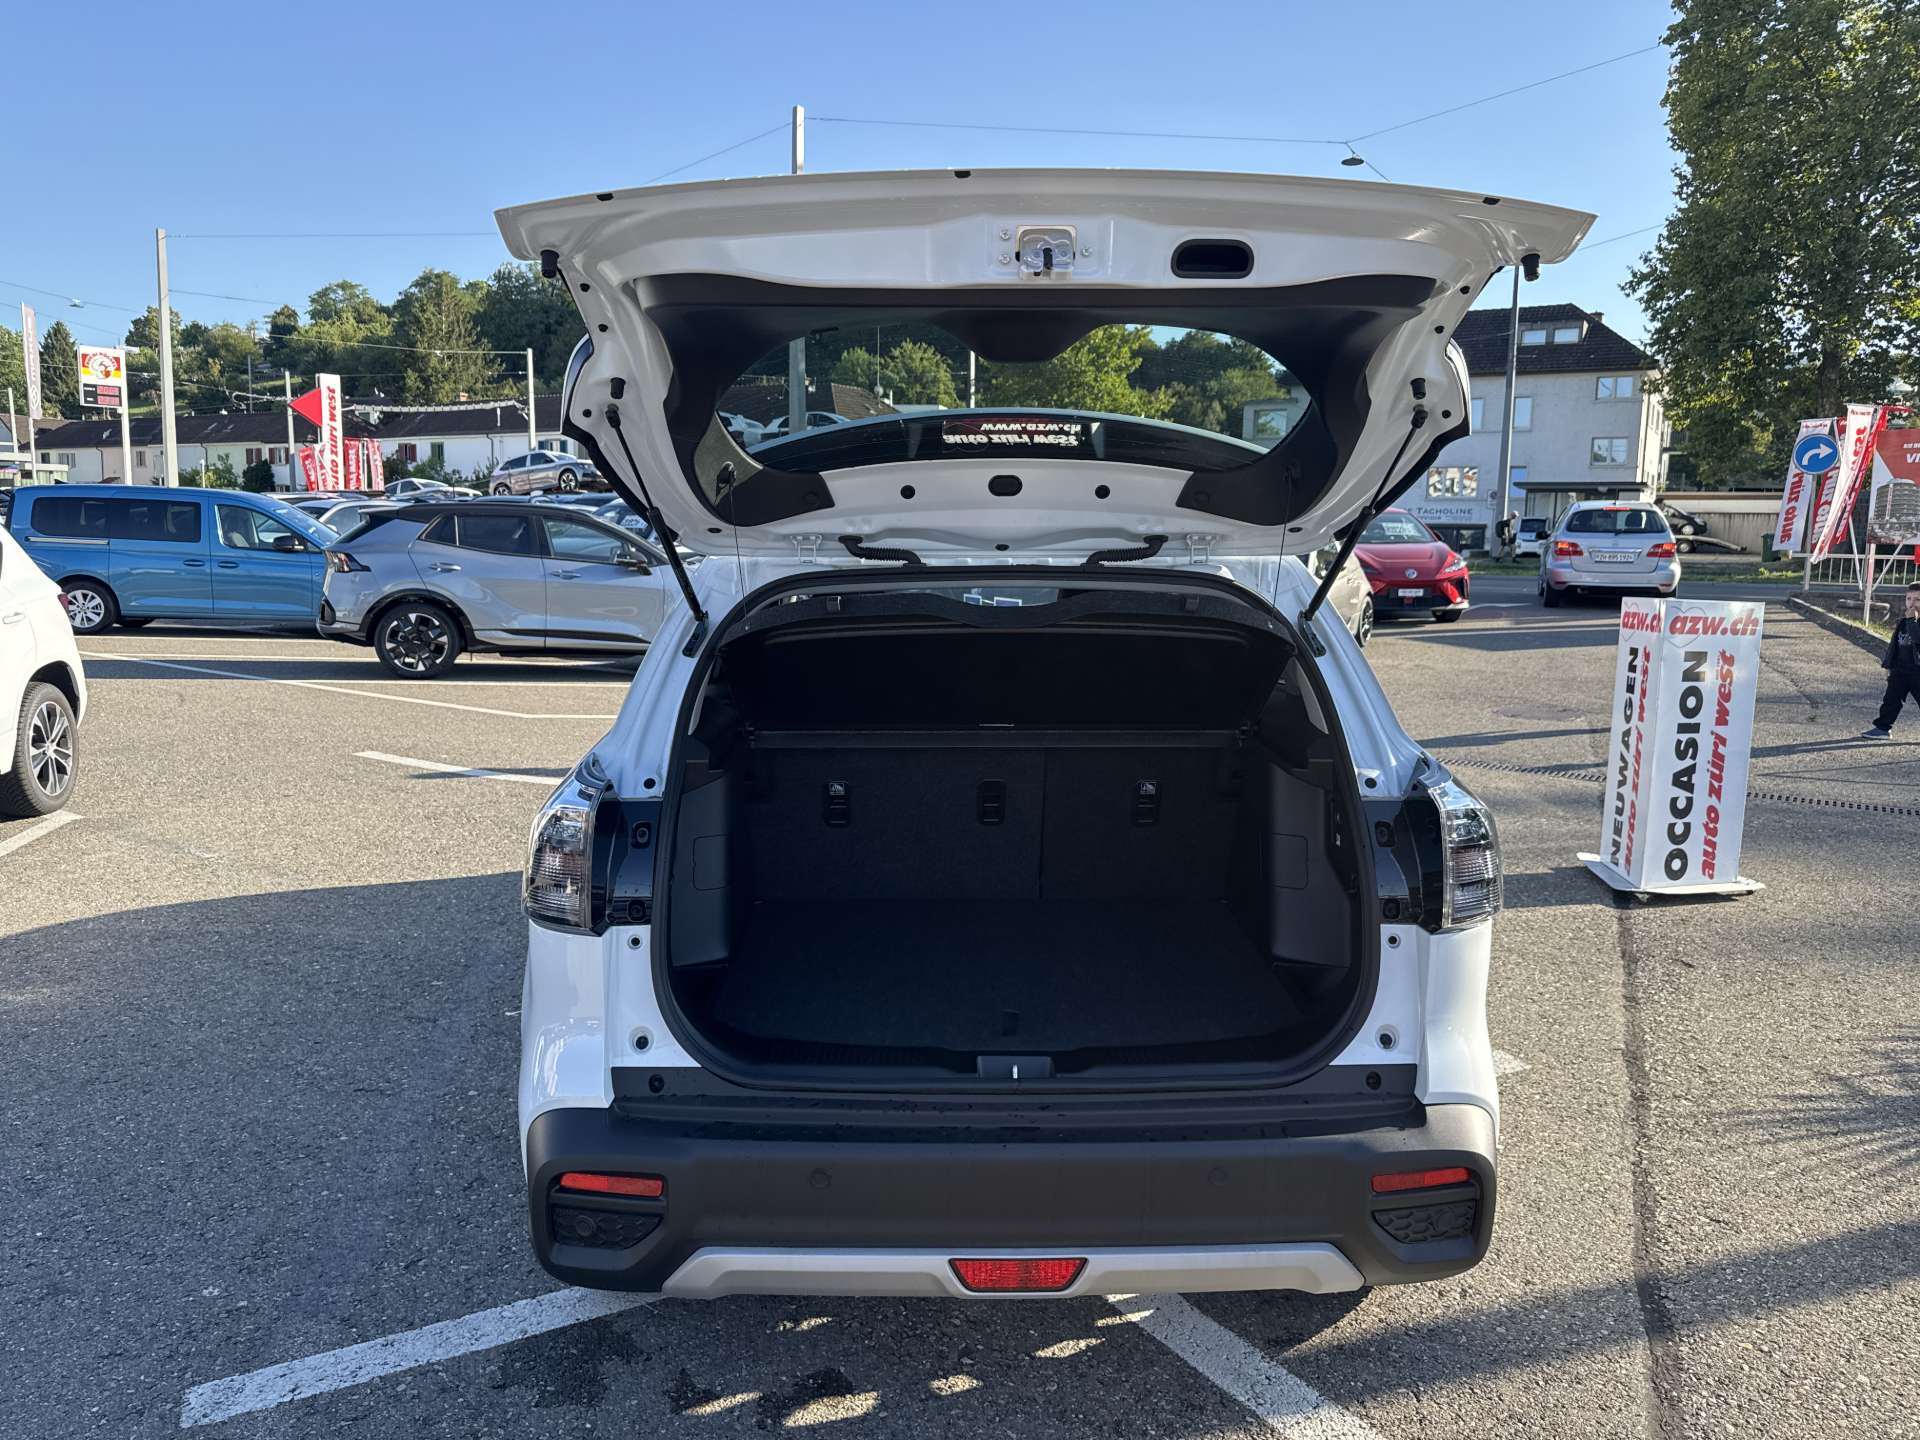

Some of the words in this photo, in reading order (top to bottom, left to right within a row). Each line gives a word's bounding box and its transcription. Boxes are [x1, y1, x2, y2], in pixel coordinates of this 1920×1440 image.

[327, 386, 336, 422] west
[1416, 507, 1473, 515] TACHOLINE
[1669, 608, 1760, 636] azw.ch
[1715, 648, 1736, 727] west
[1610, 647, 1639, 866] NEUWAGEN
[1624, 800, 1637, 876] auto
[1638, 645, 1651, 723] west
[1664, 651, 1708, 881] OCCASION
[1708, 730, 1727, 804] züri
[1702, 804, 1720, 880] auto
